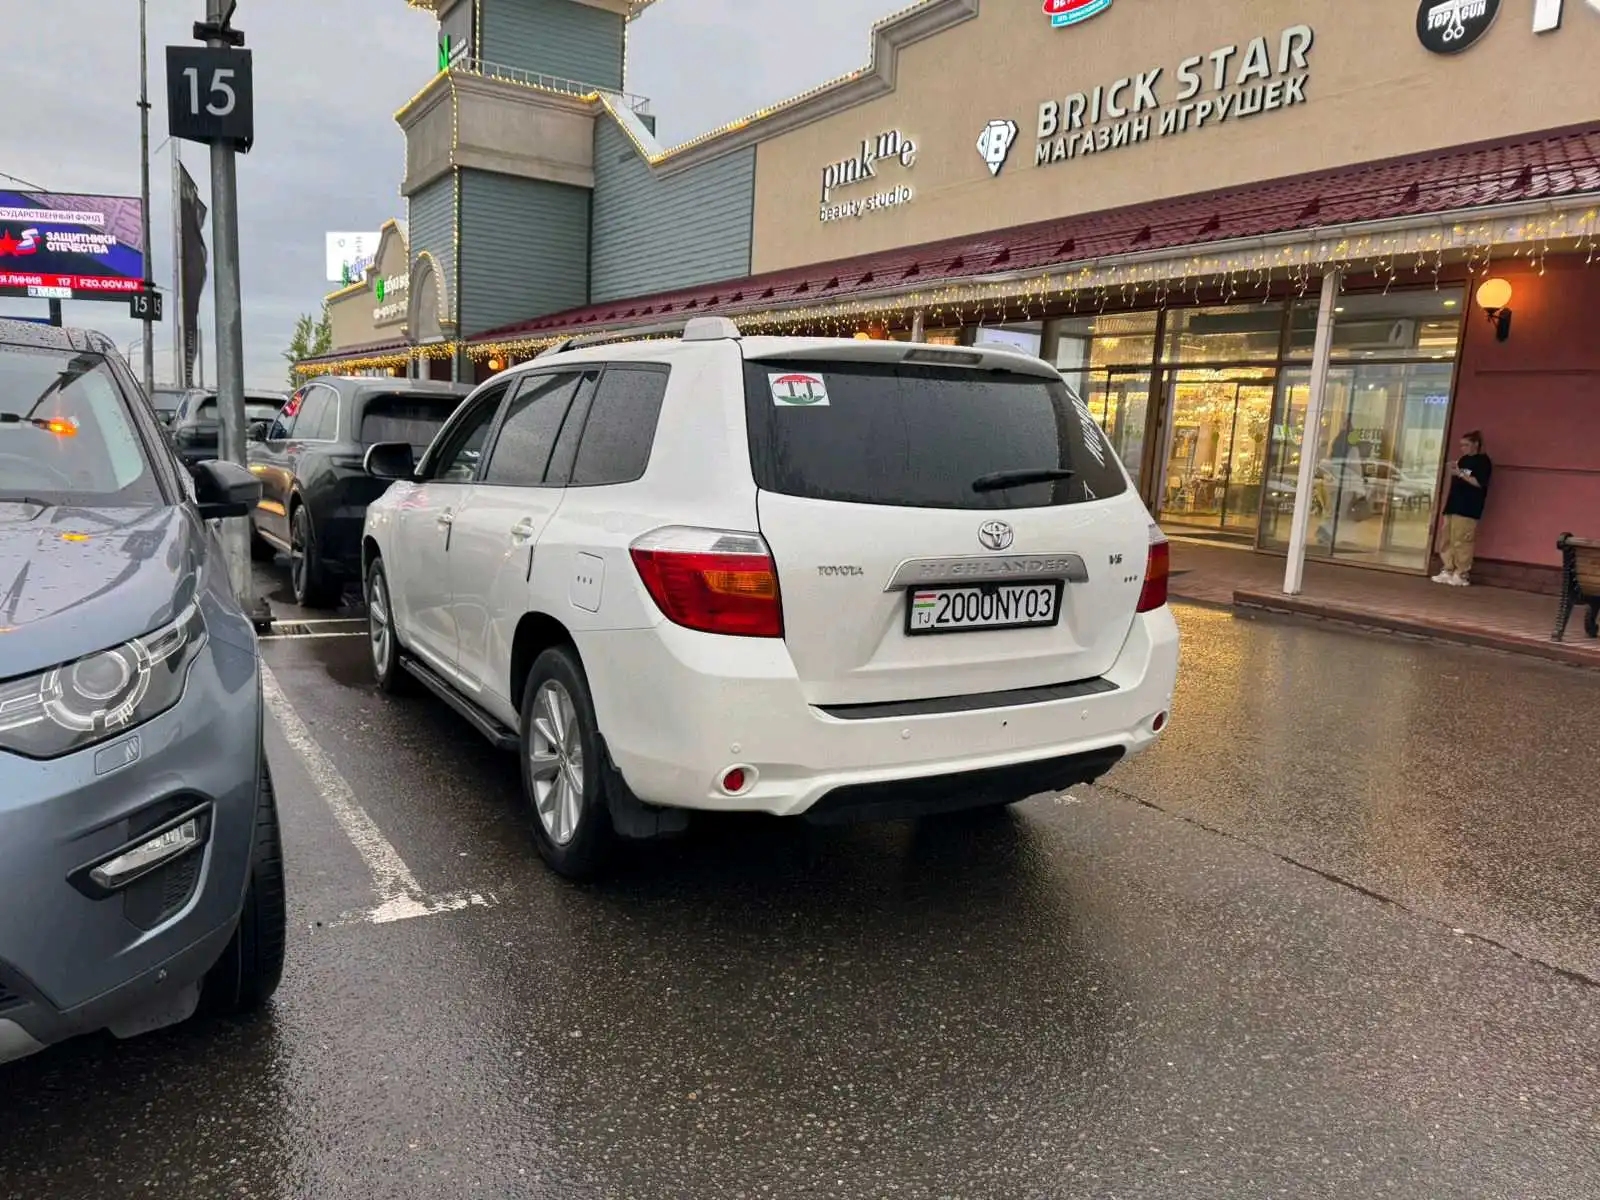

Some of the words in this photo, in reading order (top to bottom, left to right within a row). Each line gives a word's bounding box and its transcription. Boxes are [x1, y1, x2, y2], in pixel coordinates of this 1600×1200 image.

[1427, 11, 1451, 31] TOP
[1461, 2, 1487, 21] GUN
[1037, 67, 1163, 139] BRICK
[1176, 24, 1314, 101] STAR
[183, 67, 236, 117] 15
[1034, 115, 1151, 166] МАГАЗИН
[1158, 74, 1309, 135] ИГРУШЕК
[820, 139, 877, 203] pink
[874, 129, 917, 168] me
[820, 199, 865, 223] beauty
[866, 184, 913, 211] studio
[75, 212, 101, 223] ФОНД
[45, 231, 117, 245] ЗАЩИТНИКИ
[46, 242, 109, 254] ОТЕЧЕСТВА
[8, 274, 42, 285] ЛИНИЯ
[133, 296, 148, 313] 15
[817, 565, 864, 577] TOYOTA
[920, 559, 1070, 578] HIGHLANDER
[936, 589, 1052, 624] 2000NY03
[917, 611, 931, 625] TJ
